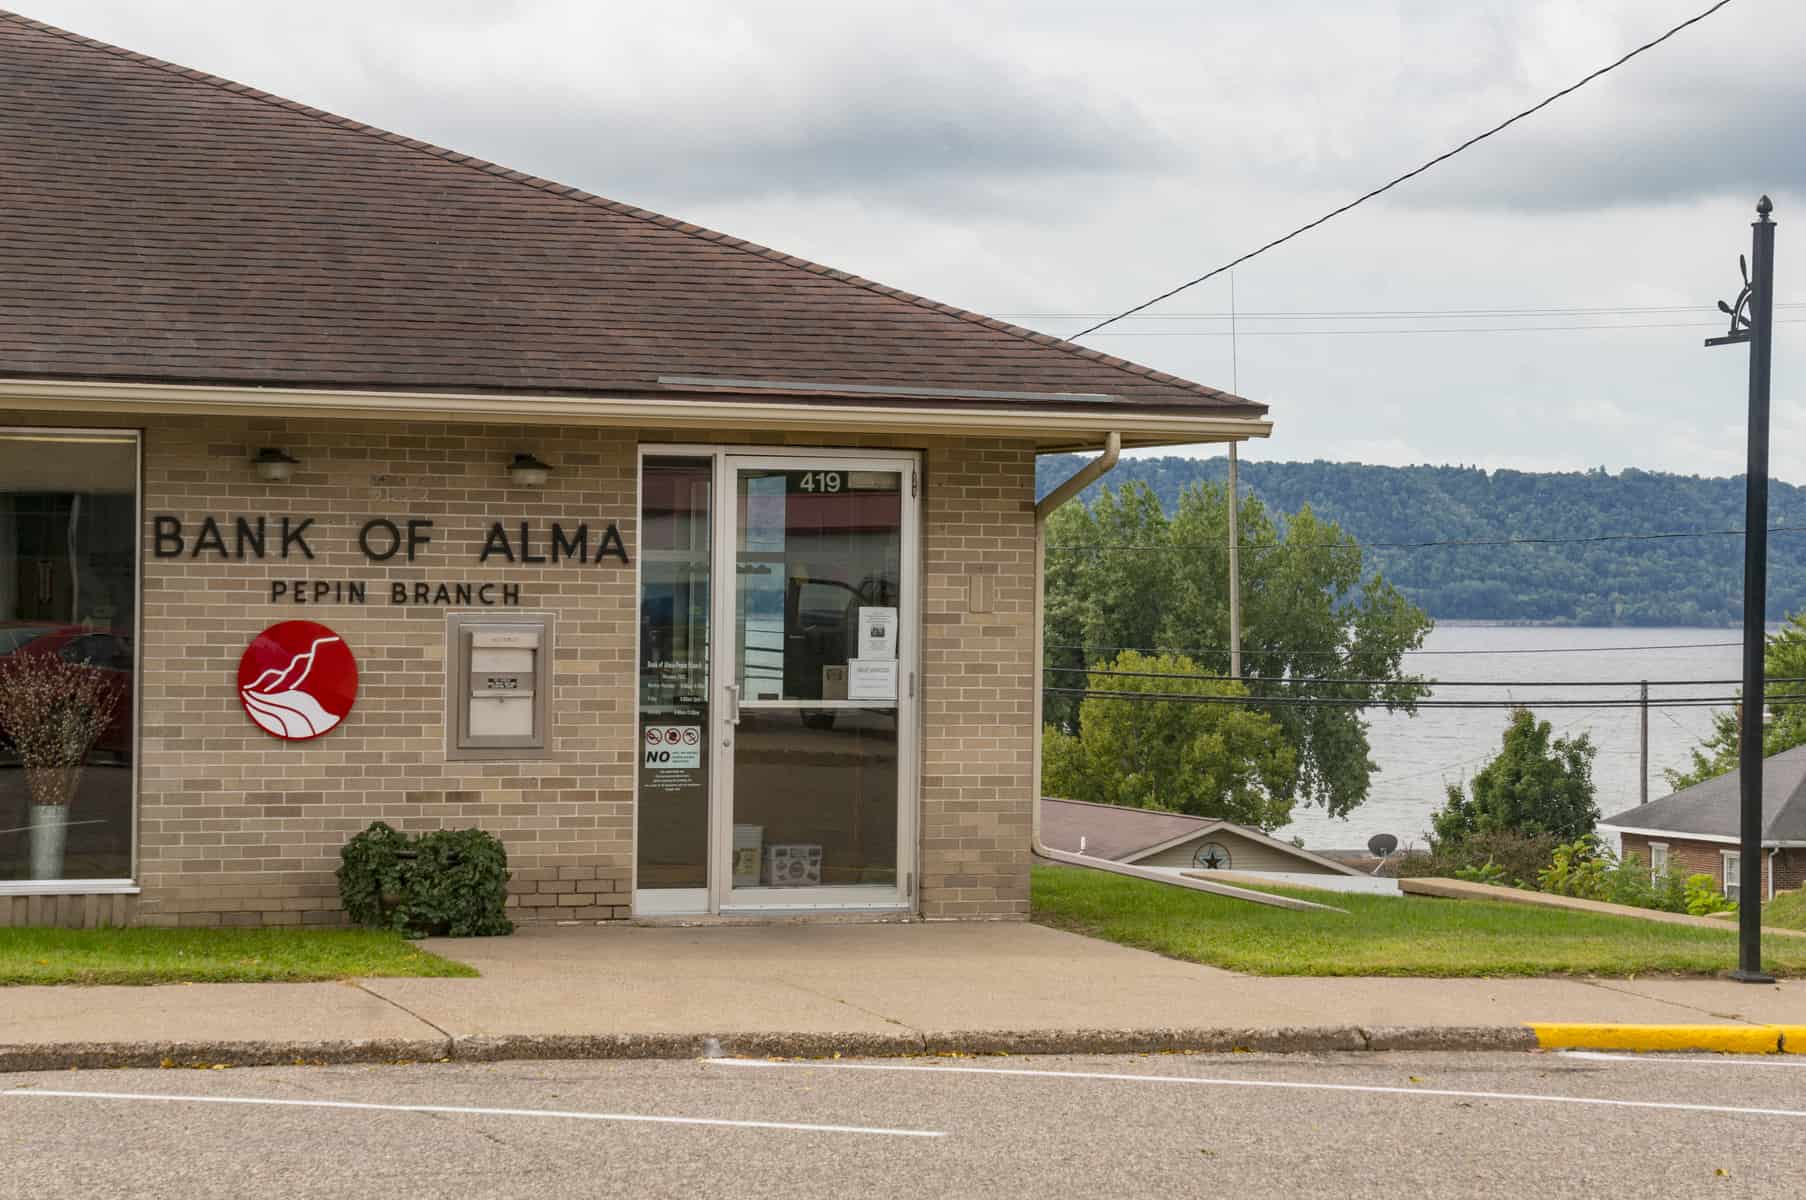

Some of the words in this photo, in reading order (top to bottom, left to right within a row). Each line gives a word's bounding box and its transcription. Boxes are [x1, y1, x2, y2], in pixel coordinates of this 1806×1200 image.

[800, 472, 841, 492] 419
[154, 516, 315, 559] BANK
[359, 519, 434, 561] OF
[480, 521, 630, 564] ALMA
[271, 580, 366, 604] PEPIN
[391, 582, 520, 605] BRANCH
[646, 751, 670, 763] NO
